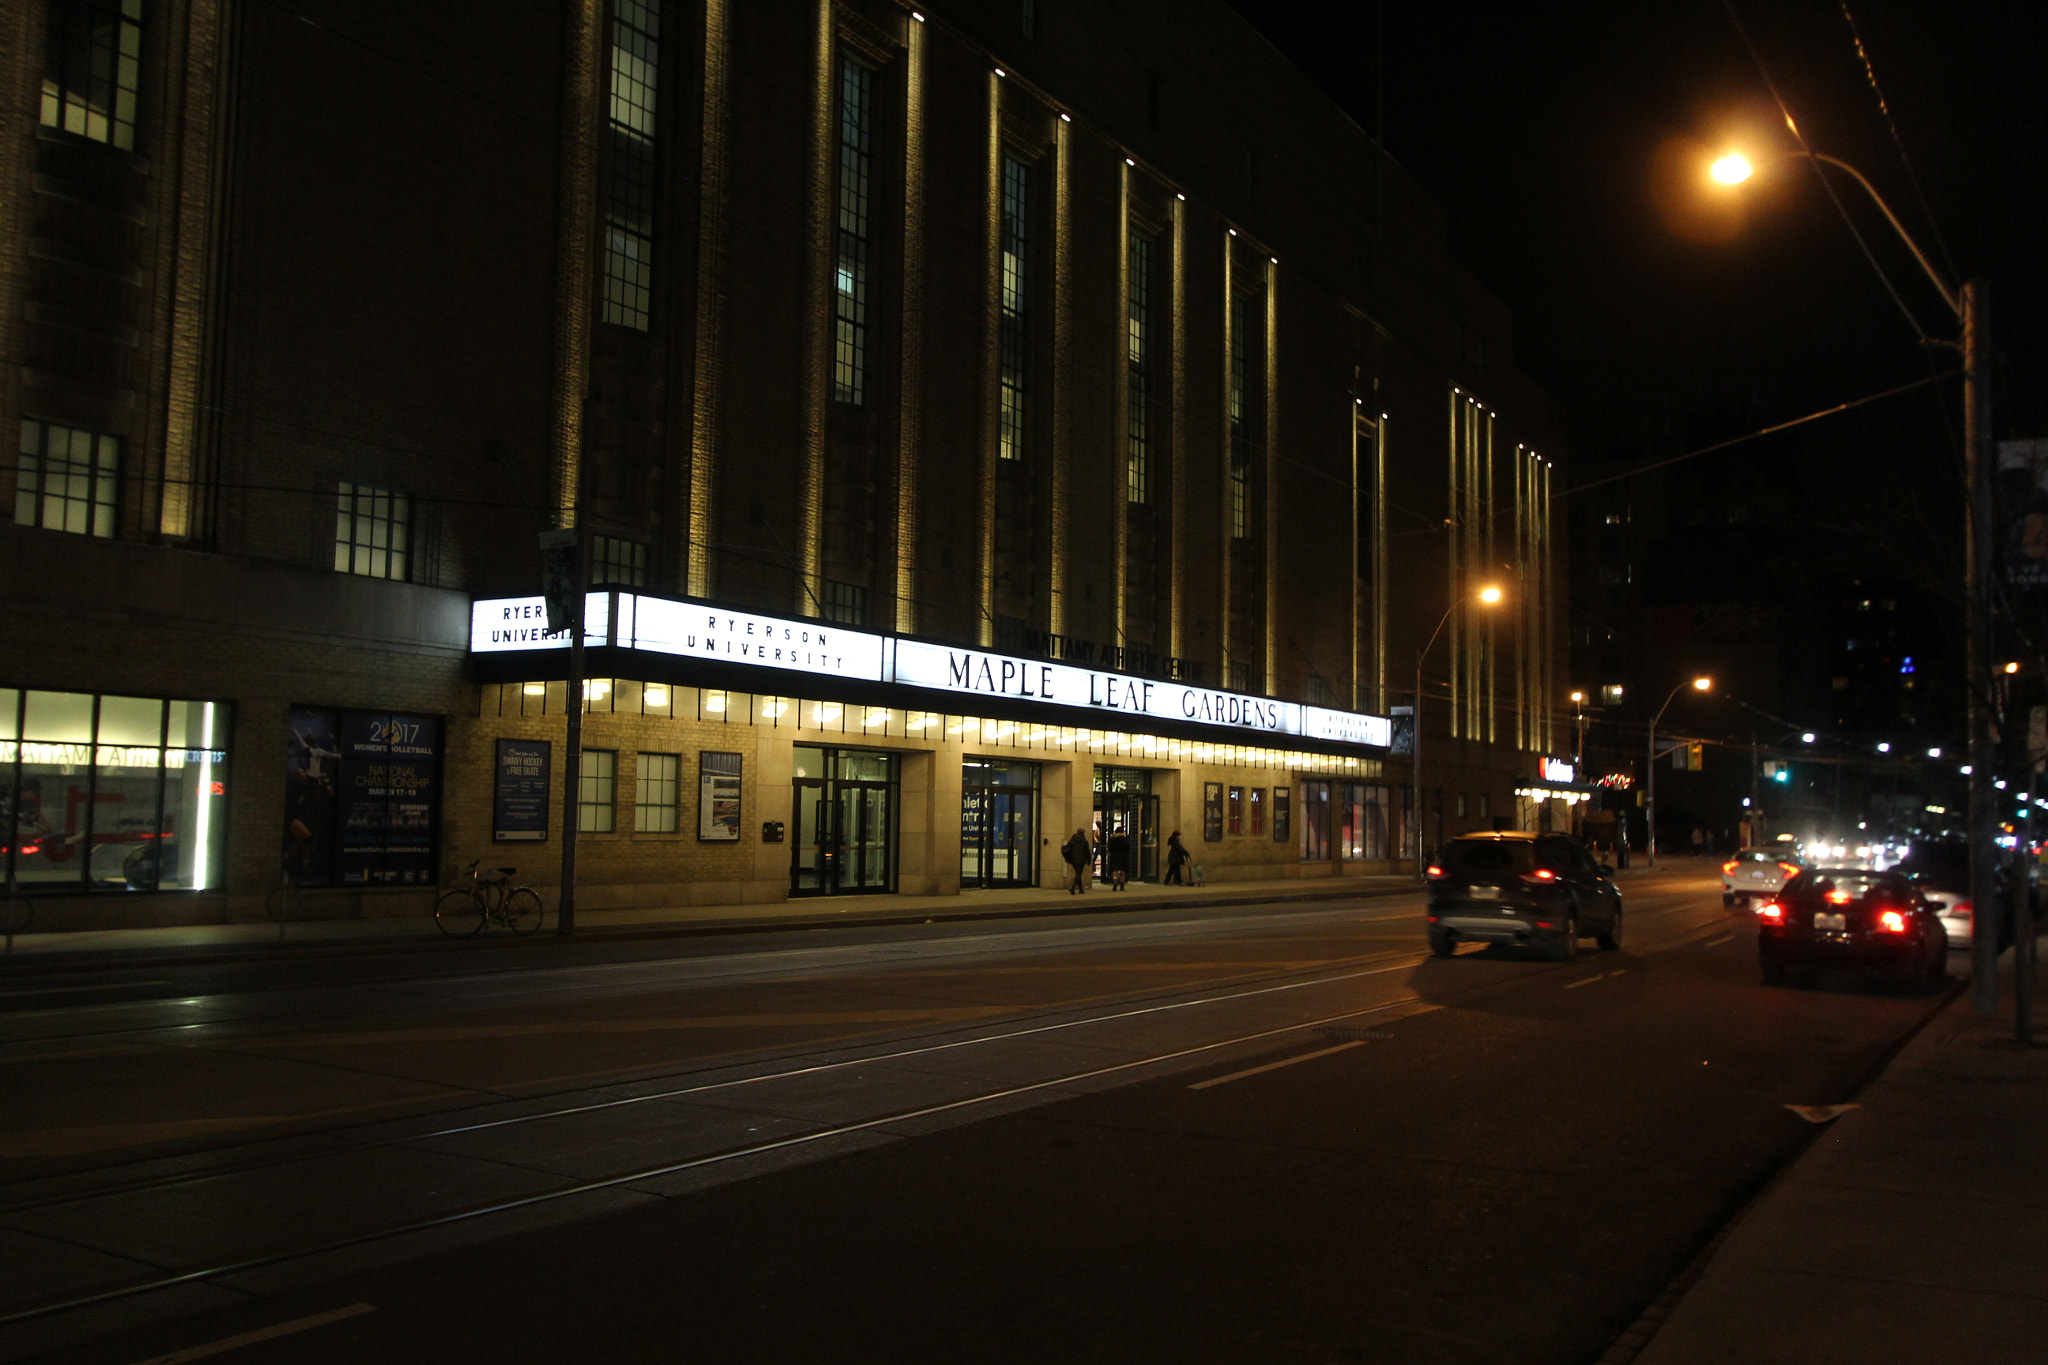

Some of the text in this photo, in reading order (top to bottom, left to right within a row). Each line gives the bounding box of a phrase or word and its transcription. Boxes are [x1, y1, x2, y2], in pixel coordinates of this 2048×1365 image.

[708, 616, 827, 646] RYERSON
[687, 635, 842, 669] UNIVERSITY
[948, 651, 1277, 729] MAPLE LEAF GARDENS
